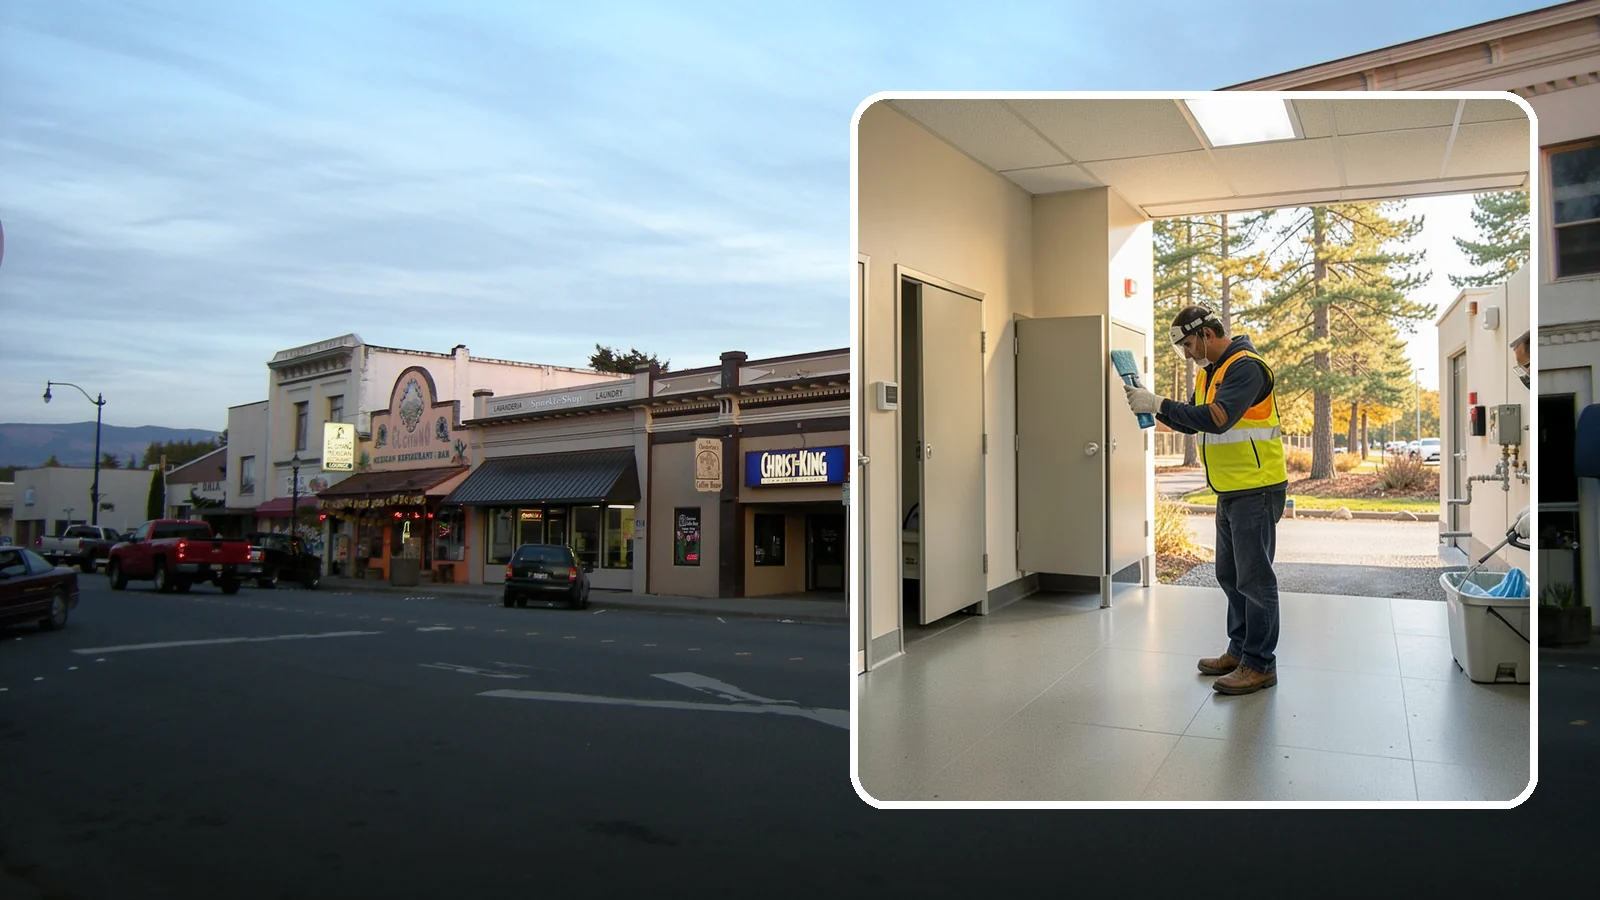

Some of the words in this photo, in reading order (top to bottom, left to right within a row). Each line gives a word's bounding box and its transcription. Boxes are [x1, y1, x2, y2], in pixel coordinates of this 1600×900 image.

[494, 402, 522, 412] LAVANDERIA
[562, 394, 582, 405] Shop
[596, 389, 623, 399] LAUNDRY
[374, 455, 396, 464] MEXICAN
[398, 451, 433, 462] RESTAURANT
[438, 450, 450, 459] BAR
[761, 452, 797, 478] CHRIST
[799, 450, 827, 476] KING
